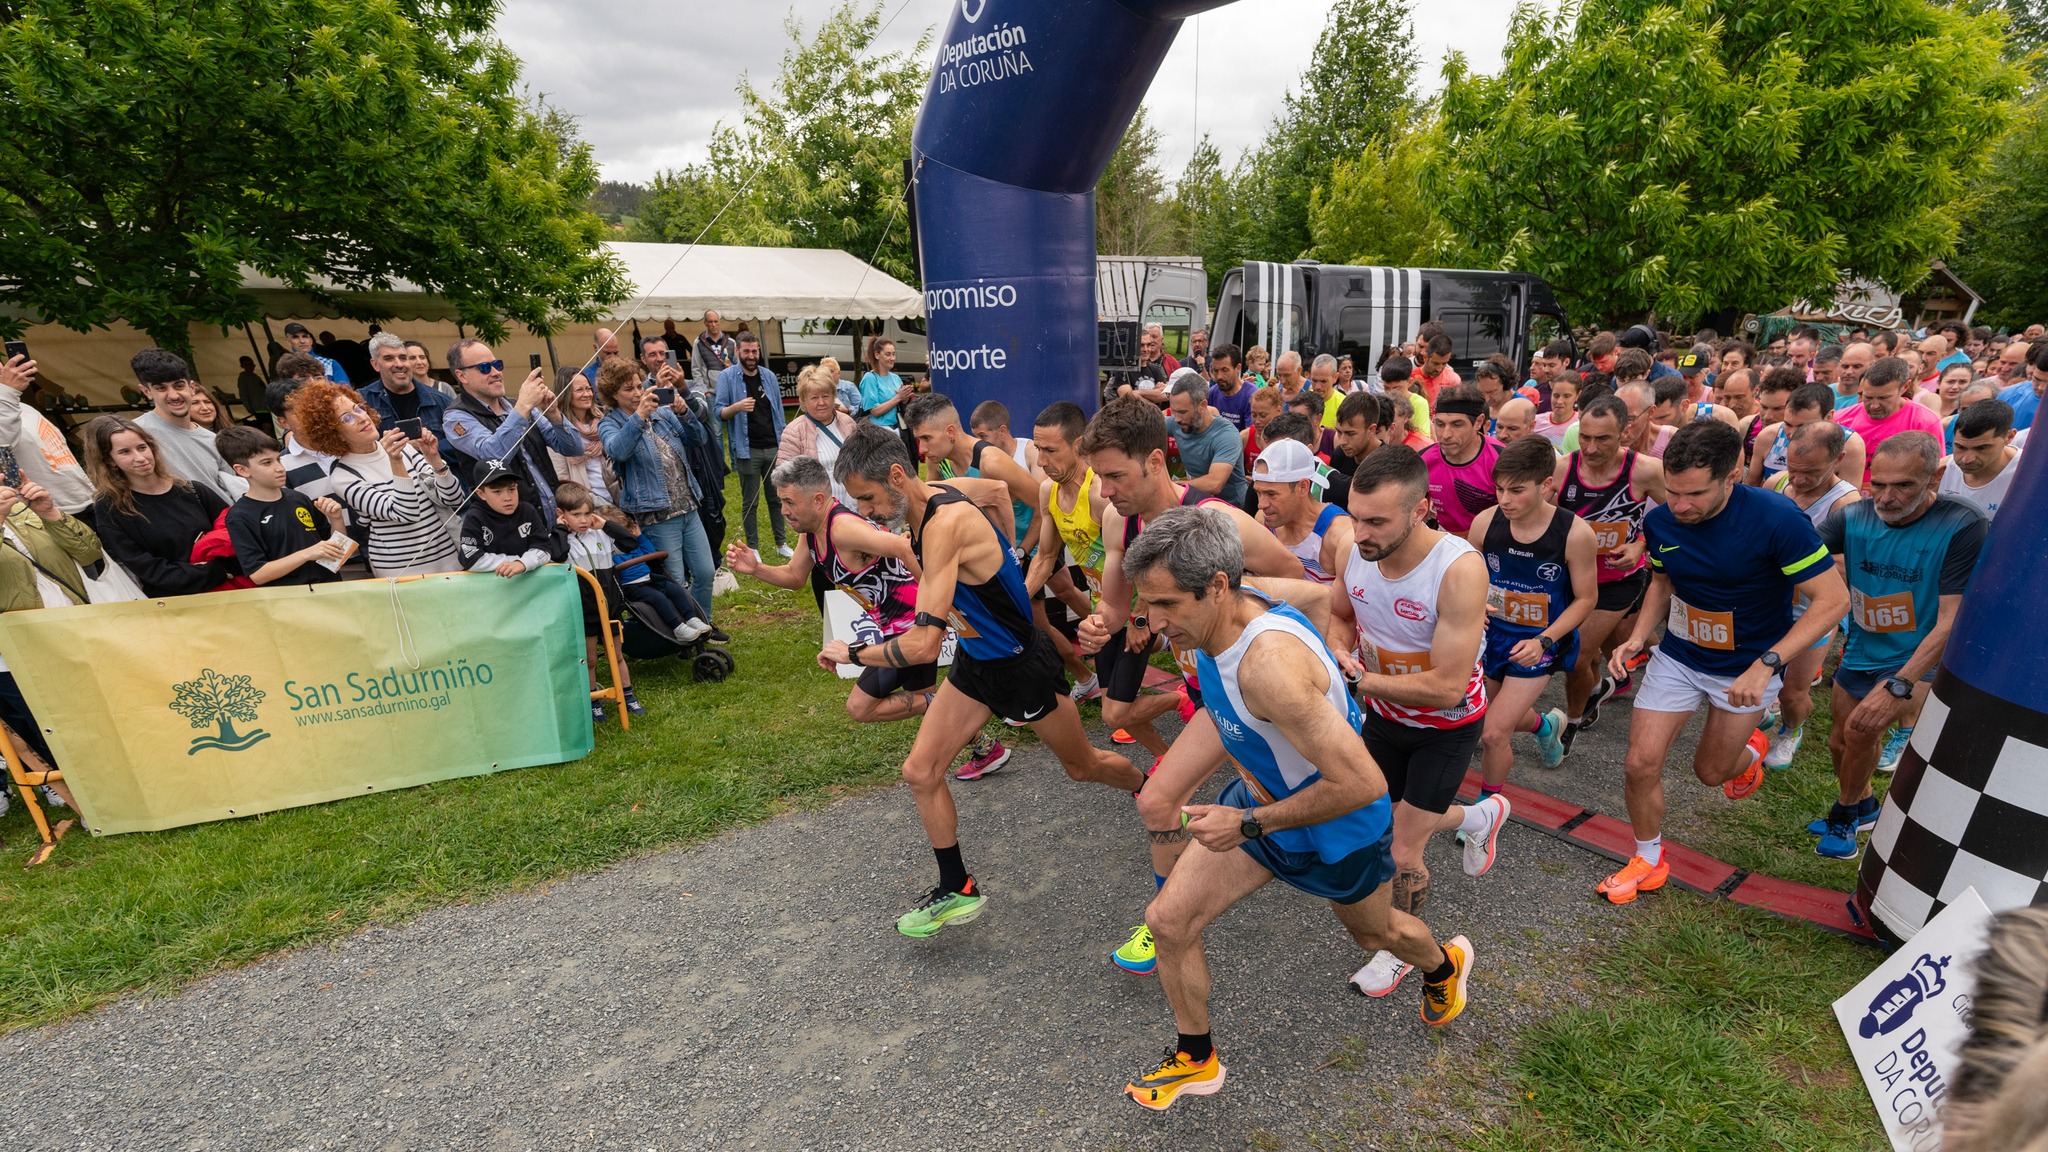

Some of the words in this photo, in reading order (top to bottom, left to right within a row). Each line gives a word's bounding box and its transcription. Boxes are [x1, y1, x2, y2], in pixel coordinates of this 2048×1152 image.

[941, 22, 1027, 68] Deputación
[940, 69, 957, 94] DA
[959, 50, 1034, 88] CORUÑA
[930, 342, 1007, 378] deporte
[1510, 581, 1544, 590] ATLETISMO
[1509, 601, 1543, 621] 215
[1866, 605, 1909, 627] 165
[1690, 619, 1728, 643] 186
[284, 680, 342, 711] San
[346, 658, 493, 702] Sadurniño
[295, 692, 451, 727] www.sansadurnino.gal
[1874, 1050, 1904, 1093] DA
[1901, 1027, 1950, 1118] Deput
[1892, 1088, 1940, 1152] CORU
